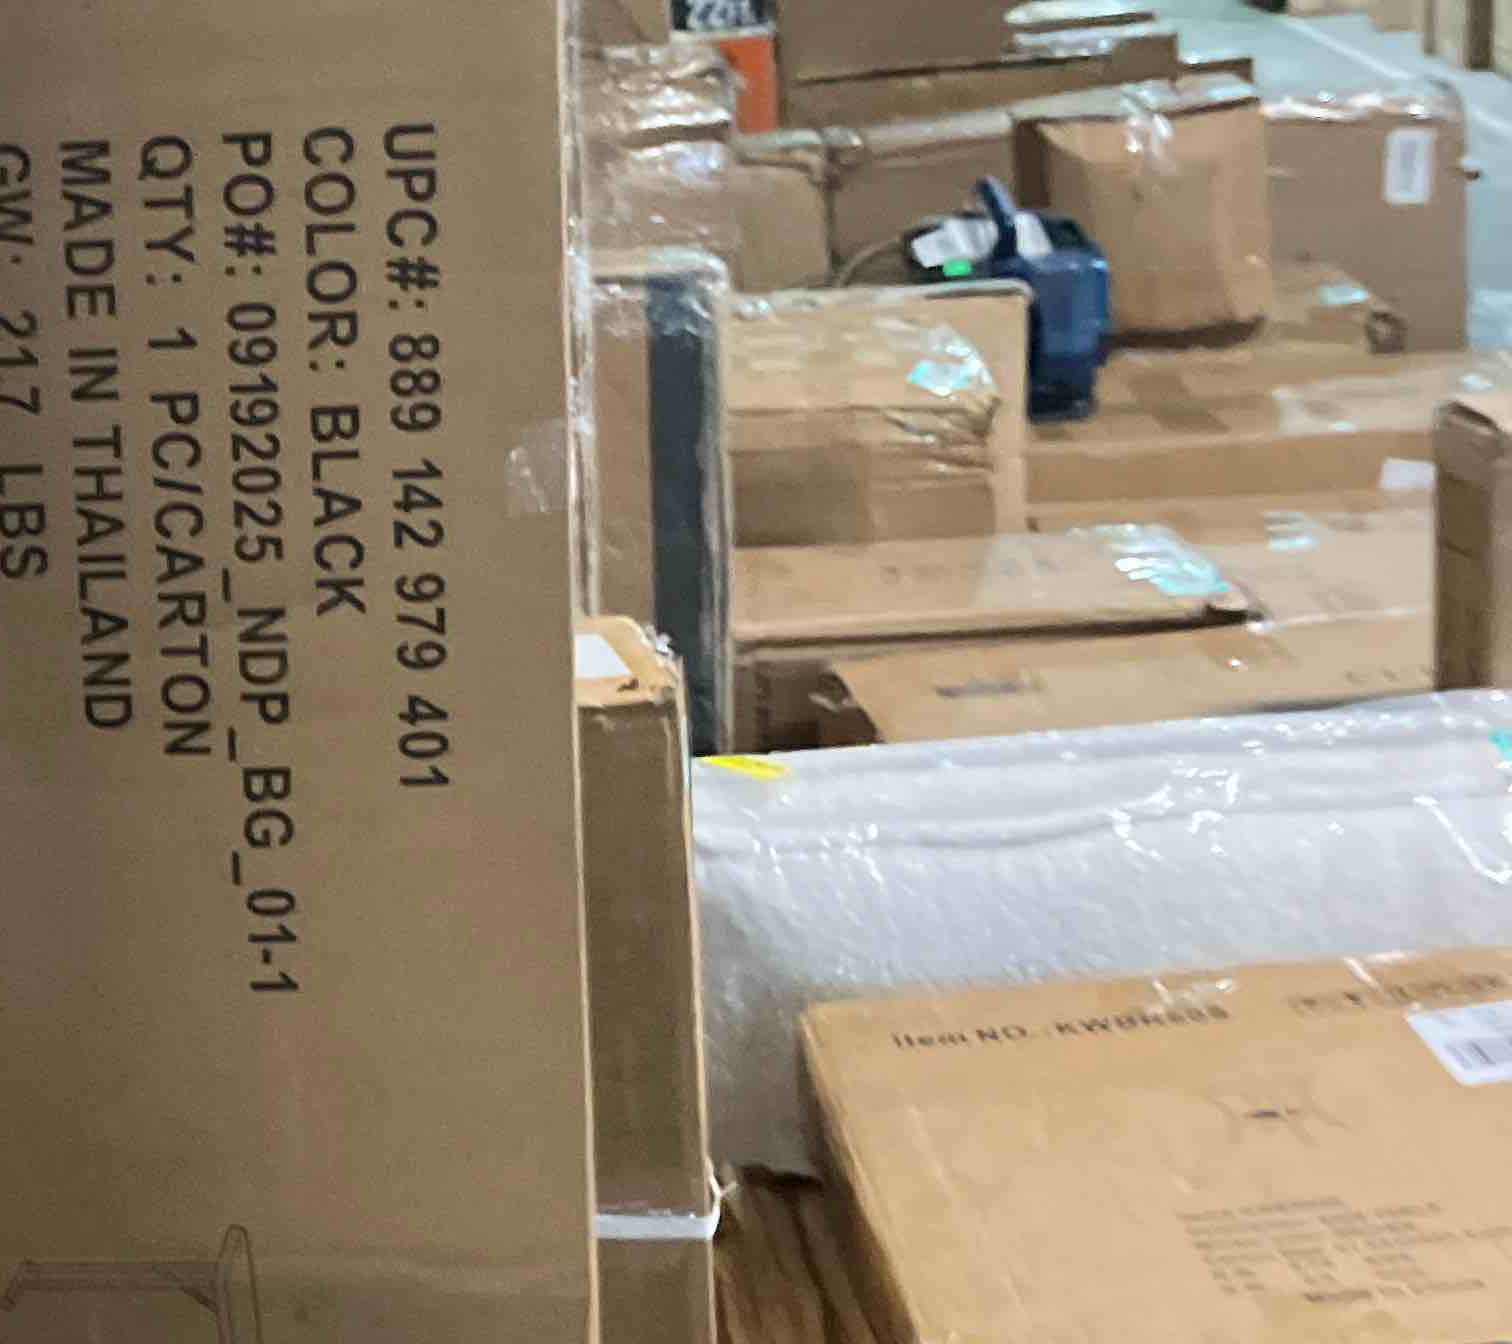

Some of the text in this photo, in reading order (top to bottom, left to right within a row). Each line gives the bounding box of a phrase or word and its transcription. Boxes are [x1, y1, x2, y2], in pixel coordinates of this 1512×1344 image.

[58, 140, 134, 730] MADE IN THAILAND
[138, 134, 211, 756] QTY: 1 PC/CARTON
[221, 132, 300, 994] PO#: 09192025_NDP_BG_01-1
[301, 126, 368, 616] COLOR: BLACK
[383, 123, 450, 790] UPC#: 889 142 979 401
